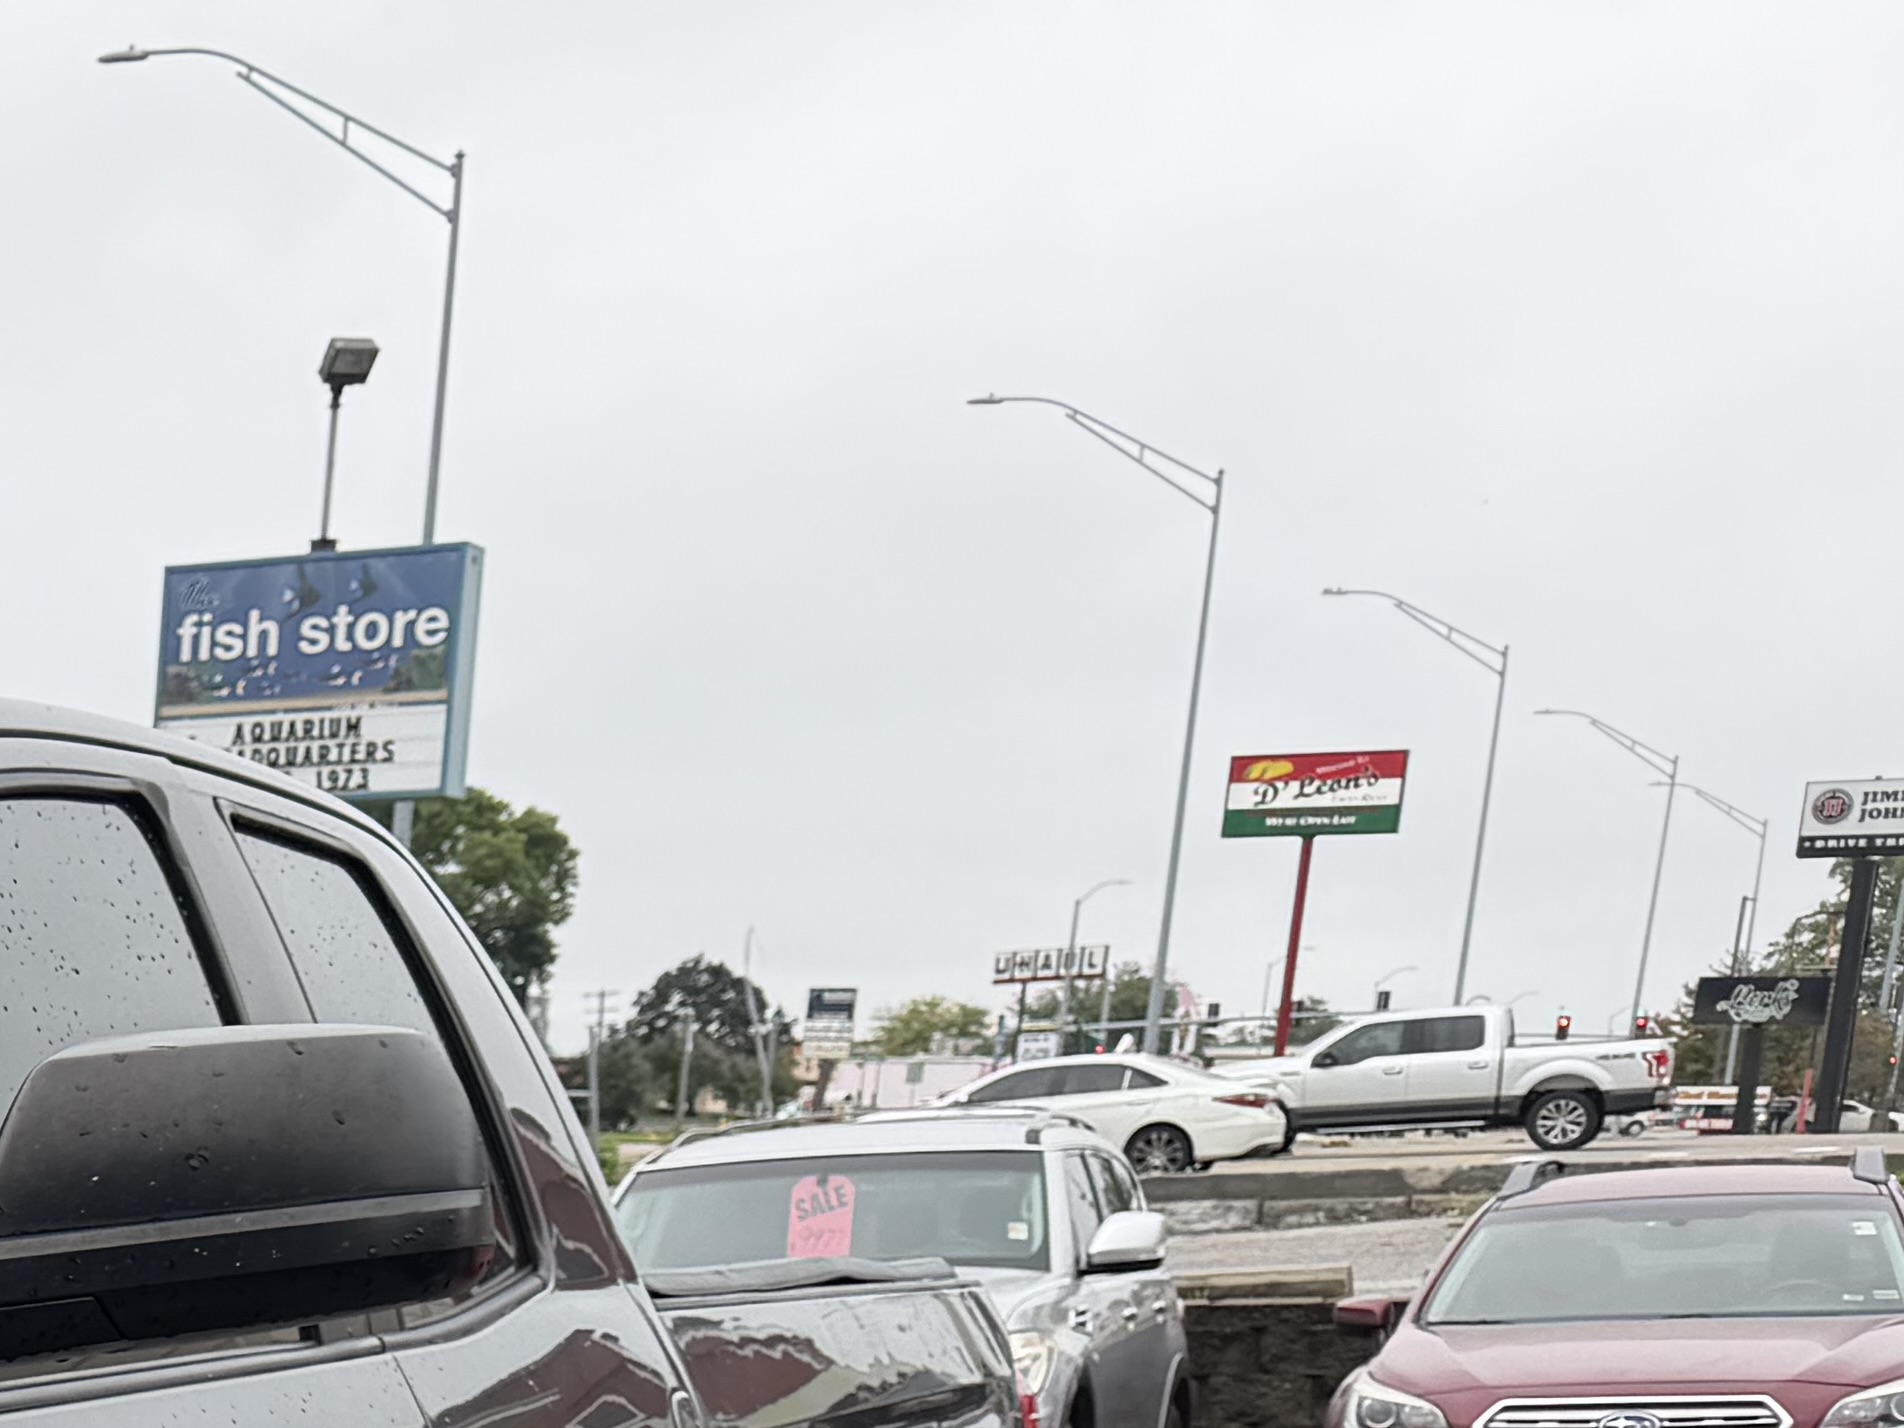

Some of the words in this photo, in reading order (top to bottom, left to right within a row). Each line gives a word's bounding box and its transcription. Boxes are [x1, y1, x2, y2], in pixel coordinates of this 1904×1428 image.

[176, 608, 280, 663] fish
[297, 604, 450, 655] store
[232, 715, 362, 746] AQUARIUM
[316, 768, 370, 792] 1973
[794, 1185, 849, 1222] SALE
